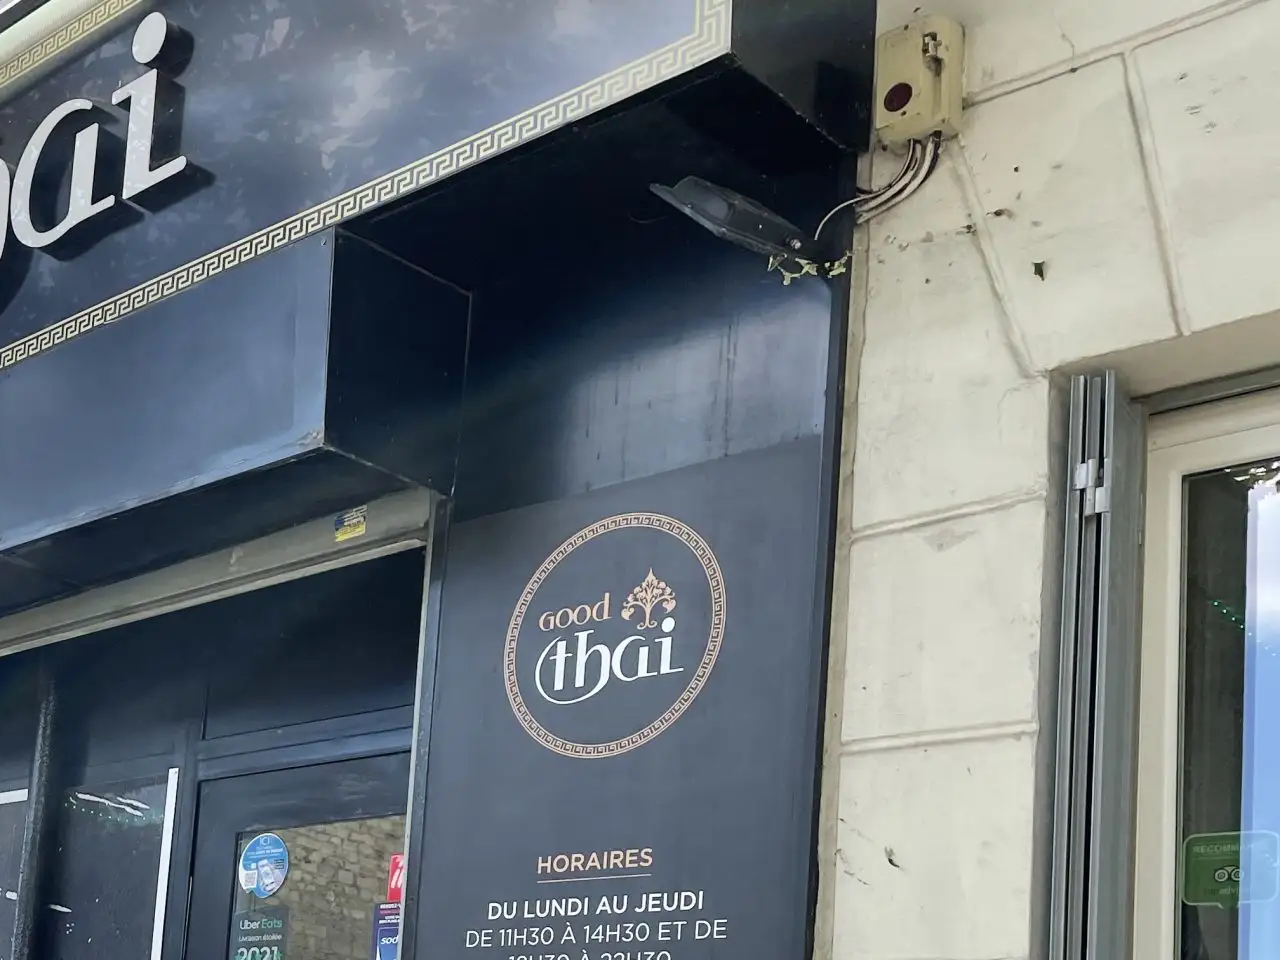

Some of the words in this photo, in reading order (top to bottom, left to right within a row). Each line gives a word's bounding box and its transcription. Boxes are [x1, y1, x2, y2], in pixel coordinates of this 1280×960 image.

[534, 616, 684, 705] thai
[536, 847, 653, 874] HORAIRES
[487, 902, 517, 920] DU
[523, 897, 589, 919] LUNDI
[596, 894, 628, 915] AU
[634, 890, 704, 913] JEUDI
[239, 919, 261, 930] Uber
[261, 918, 282, 930] Eats
[465, 930, 493, 948] DE
[499, 926, 554, 947] 11H30
[560, 921, 576, 945] À
[583, 922, 650, 944] 14H30
[658, 920, 687, 941] ET
[695, 918, 728, 939] DE
[380, 935, 399, 945] sod
